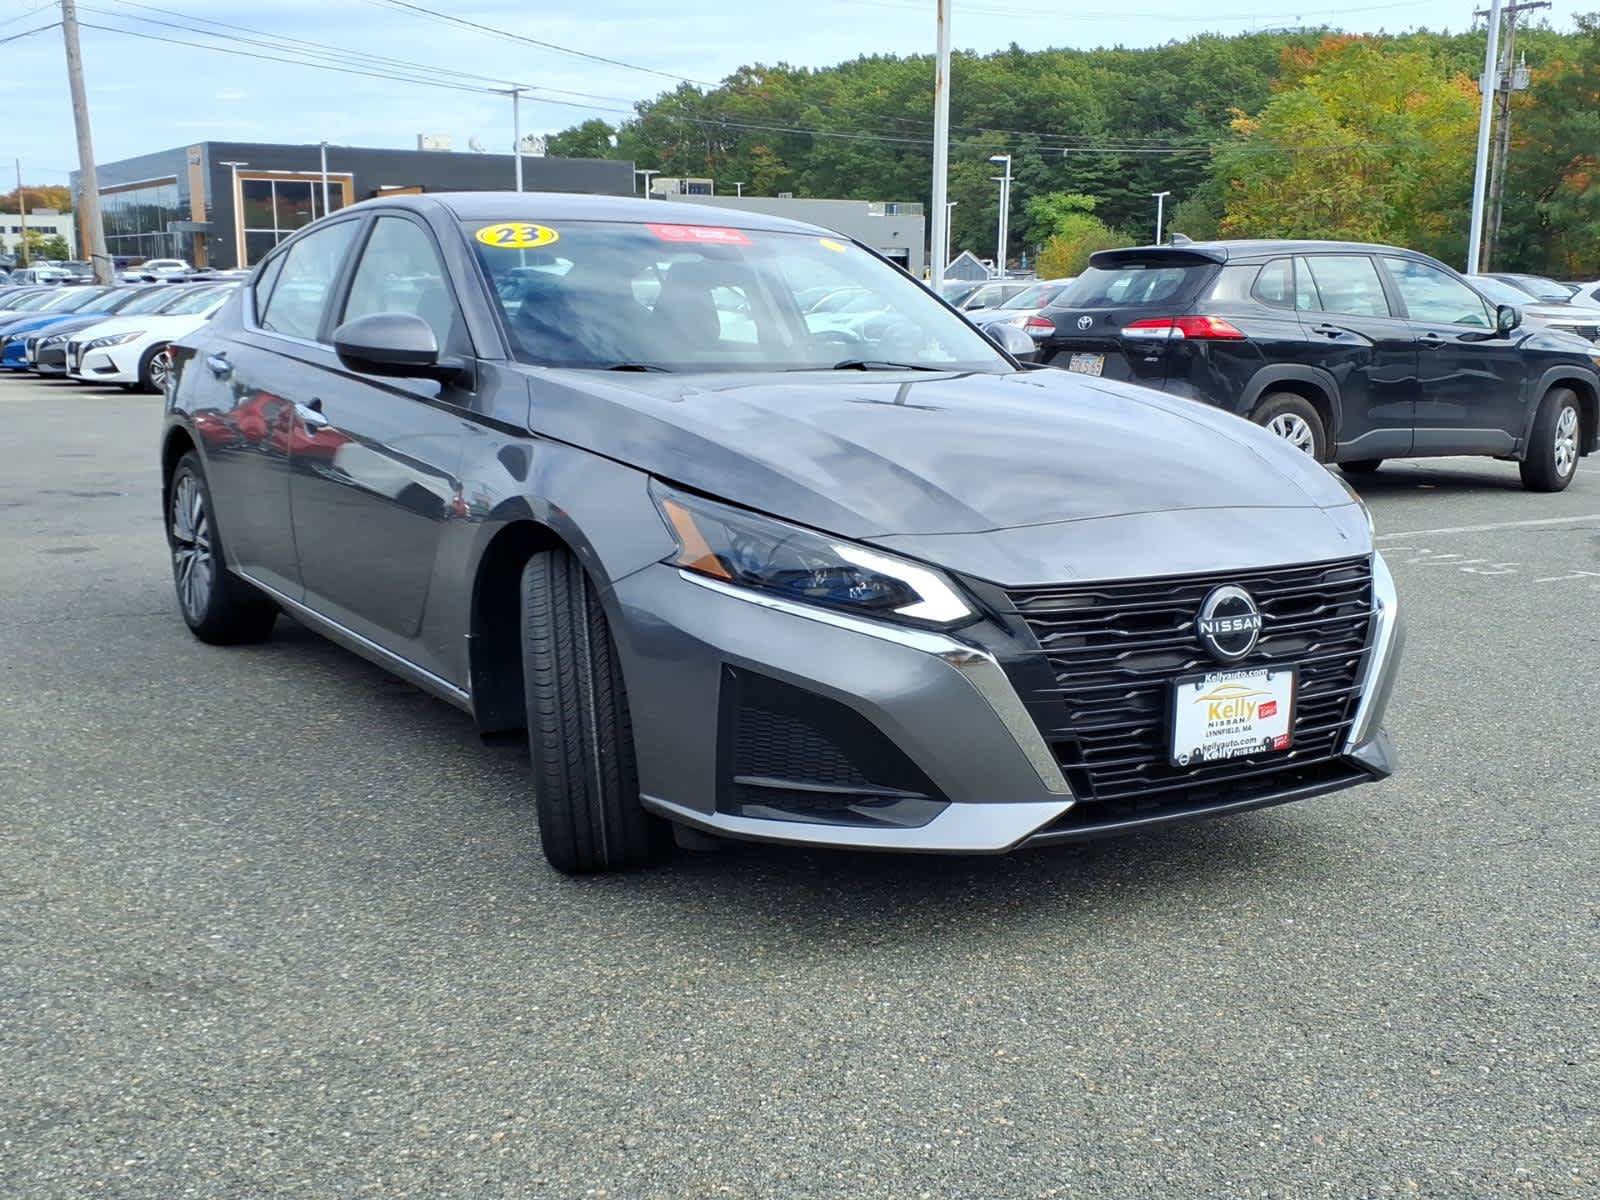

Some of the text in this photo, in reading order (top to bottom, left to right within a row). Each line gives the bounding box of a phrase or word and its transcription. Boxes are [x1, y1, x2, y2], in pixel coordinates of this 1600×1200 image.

[496, 227, 538, 243] 23
[1201, 615, 1262, 633] NISSAN
[1208, 697, 1256, 720] Kelly
[1208, 717, 1246, 728] NISSAN
[1203, 745, 1266, 761] Kelly NISSAN
